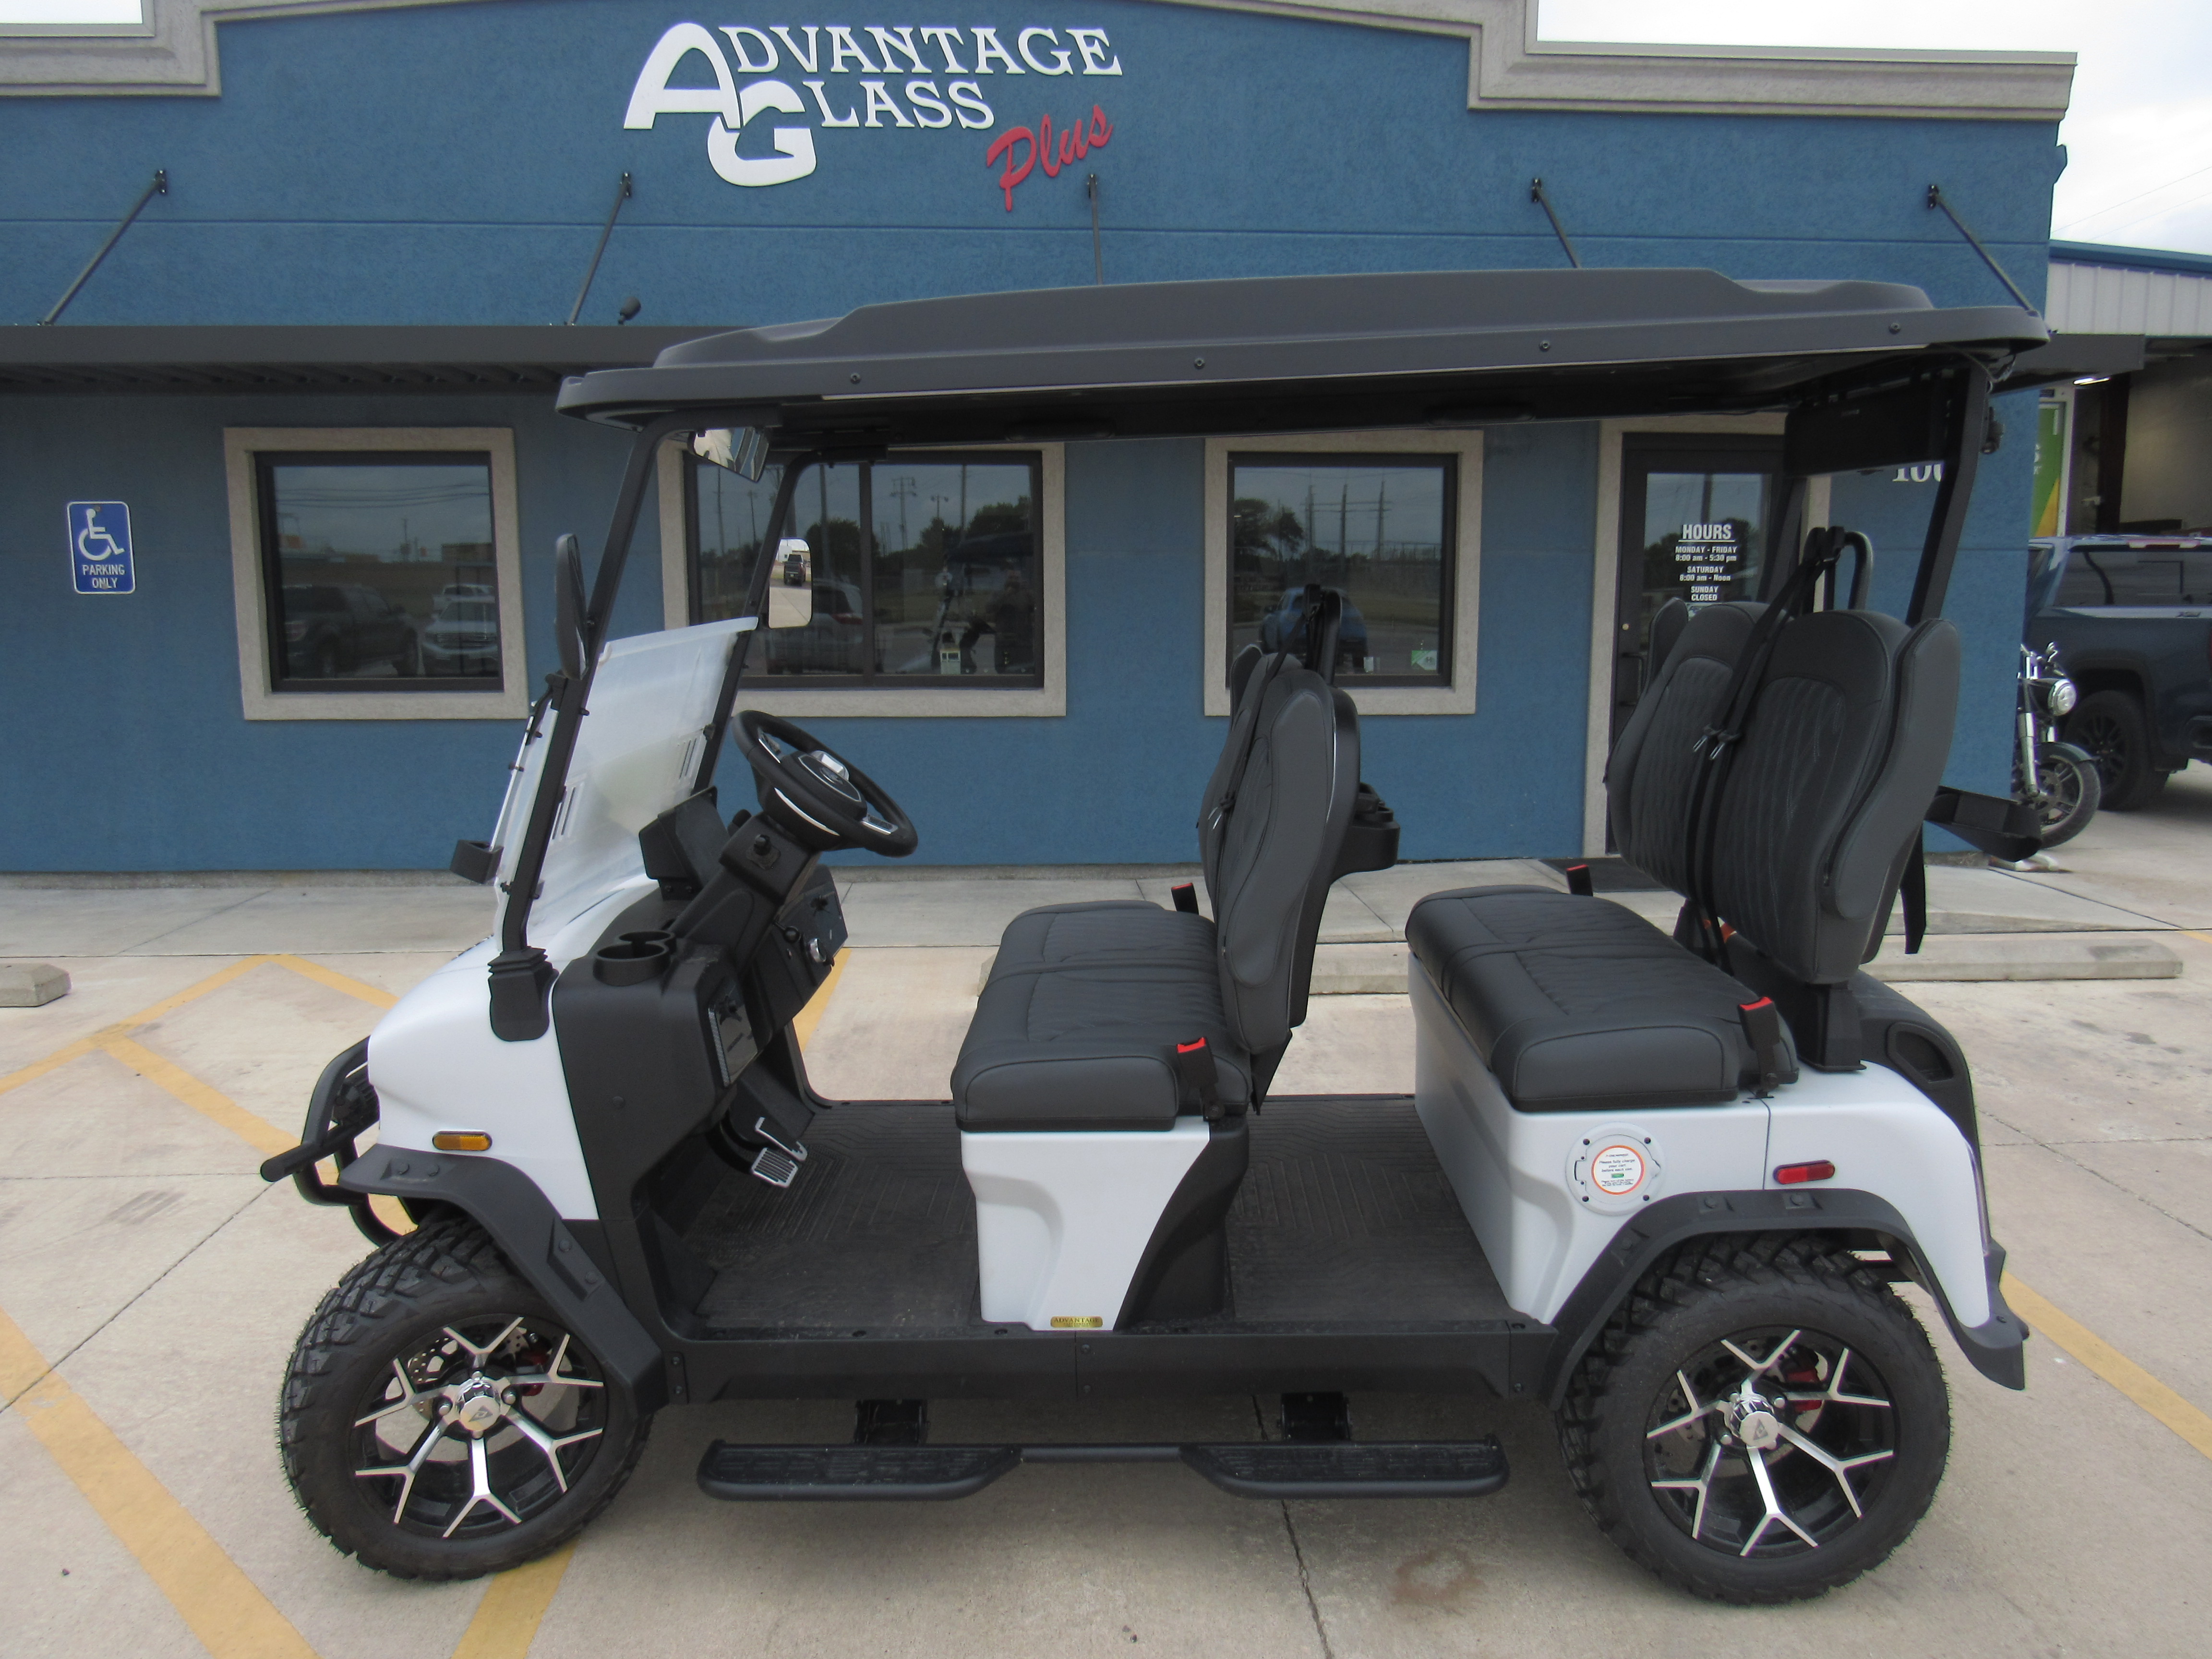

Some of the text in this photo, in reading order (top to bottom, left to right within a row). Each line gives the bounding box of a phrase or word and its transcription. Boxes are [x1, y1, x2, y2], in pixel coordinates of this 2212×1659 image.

[986, 104, 1113, 211] Plus
[1683, 524, 1732, 540] HOURS
[82, 565, 125, 576] PARKING
[92, 577, 118, 589] ONLY
